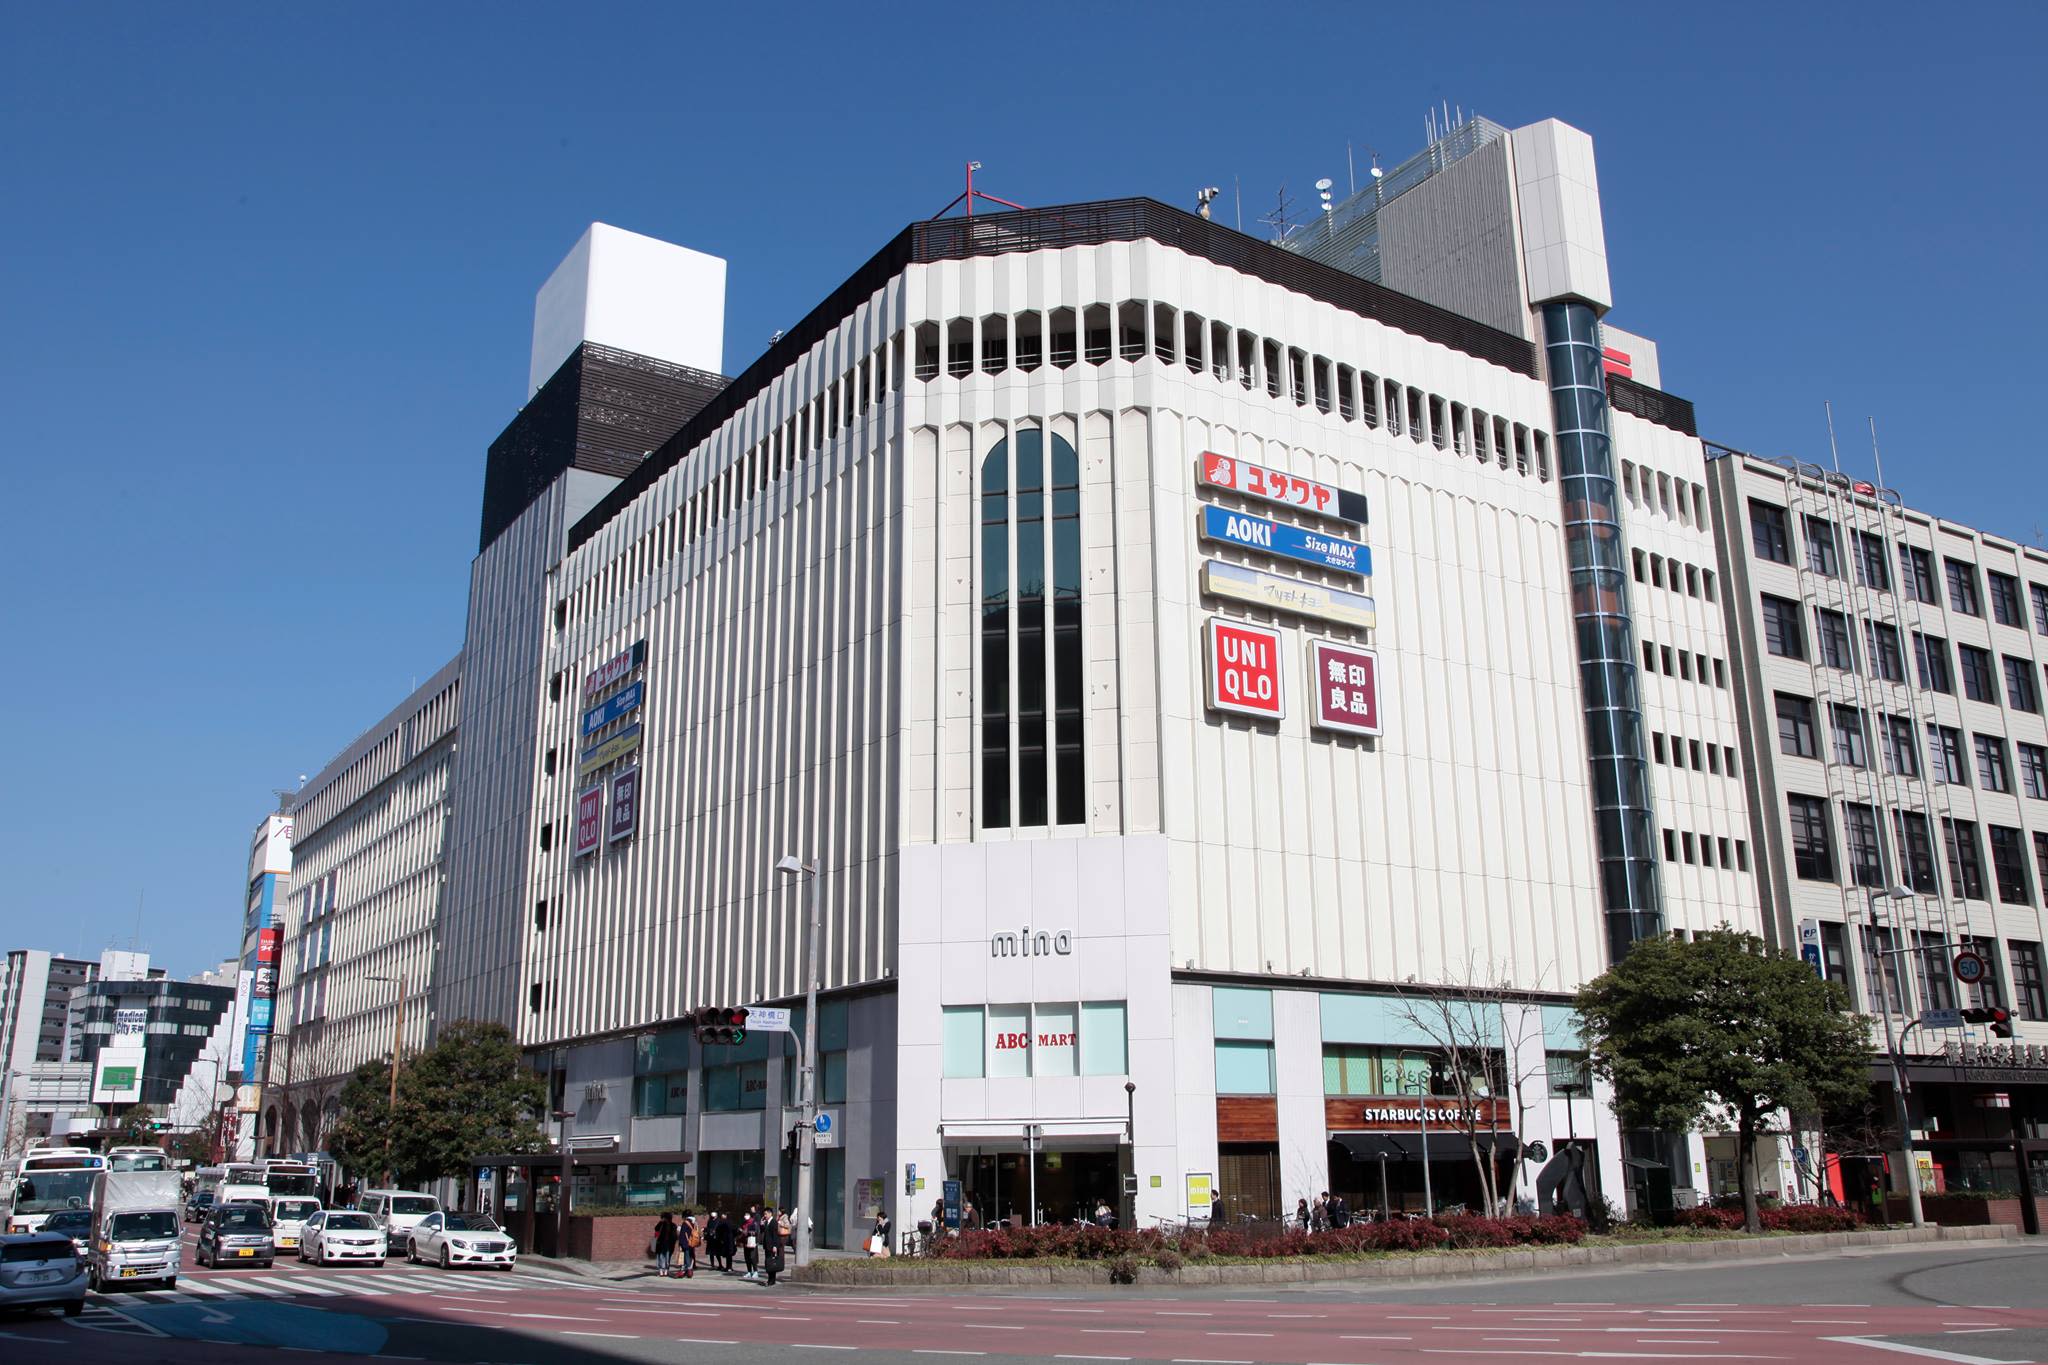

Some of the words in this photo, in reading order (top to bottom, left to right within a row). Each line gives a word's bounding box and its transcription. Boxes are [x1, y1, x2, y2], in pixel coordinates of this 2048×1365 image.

[1225, 516, 1272, 547] AOKI
[1305, 535, 1327, 552] Size
[1329, 542, 1356, 560] MAX
[1325, 555, 1356, 569] 大きなサイズ
[1223, 636, 1267, 669] UNI
[1224, 668, 1273, 700] QLO
[1327, 658, 1366, 687] 無印
[1330, 686, 1368, 716] 良品
[588, 706, 605, 730] AOKI
[581, 798, 597, 820] UNI
[580, 821, 596, 846] QLO
[991, 926, 1072, 957] mina
[1960, 960, 1979, 976] 50
[1365, 1108, 1436, 1121] STARBUCKS
[1438, 1109, 1481, 1121] COFE
